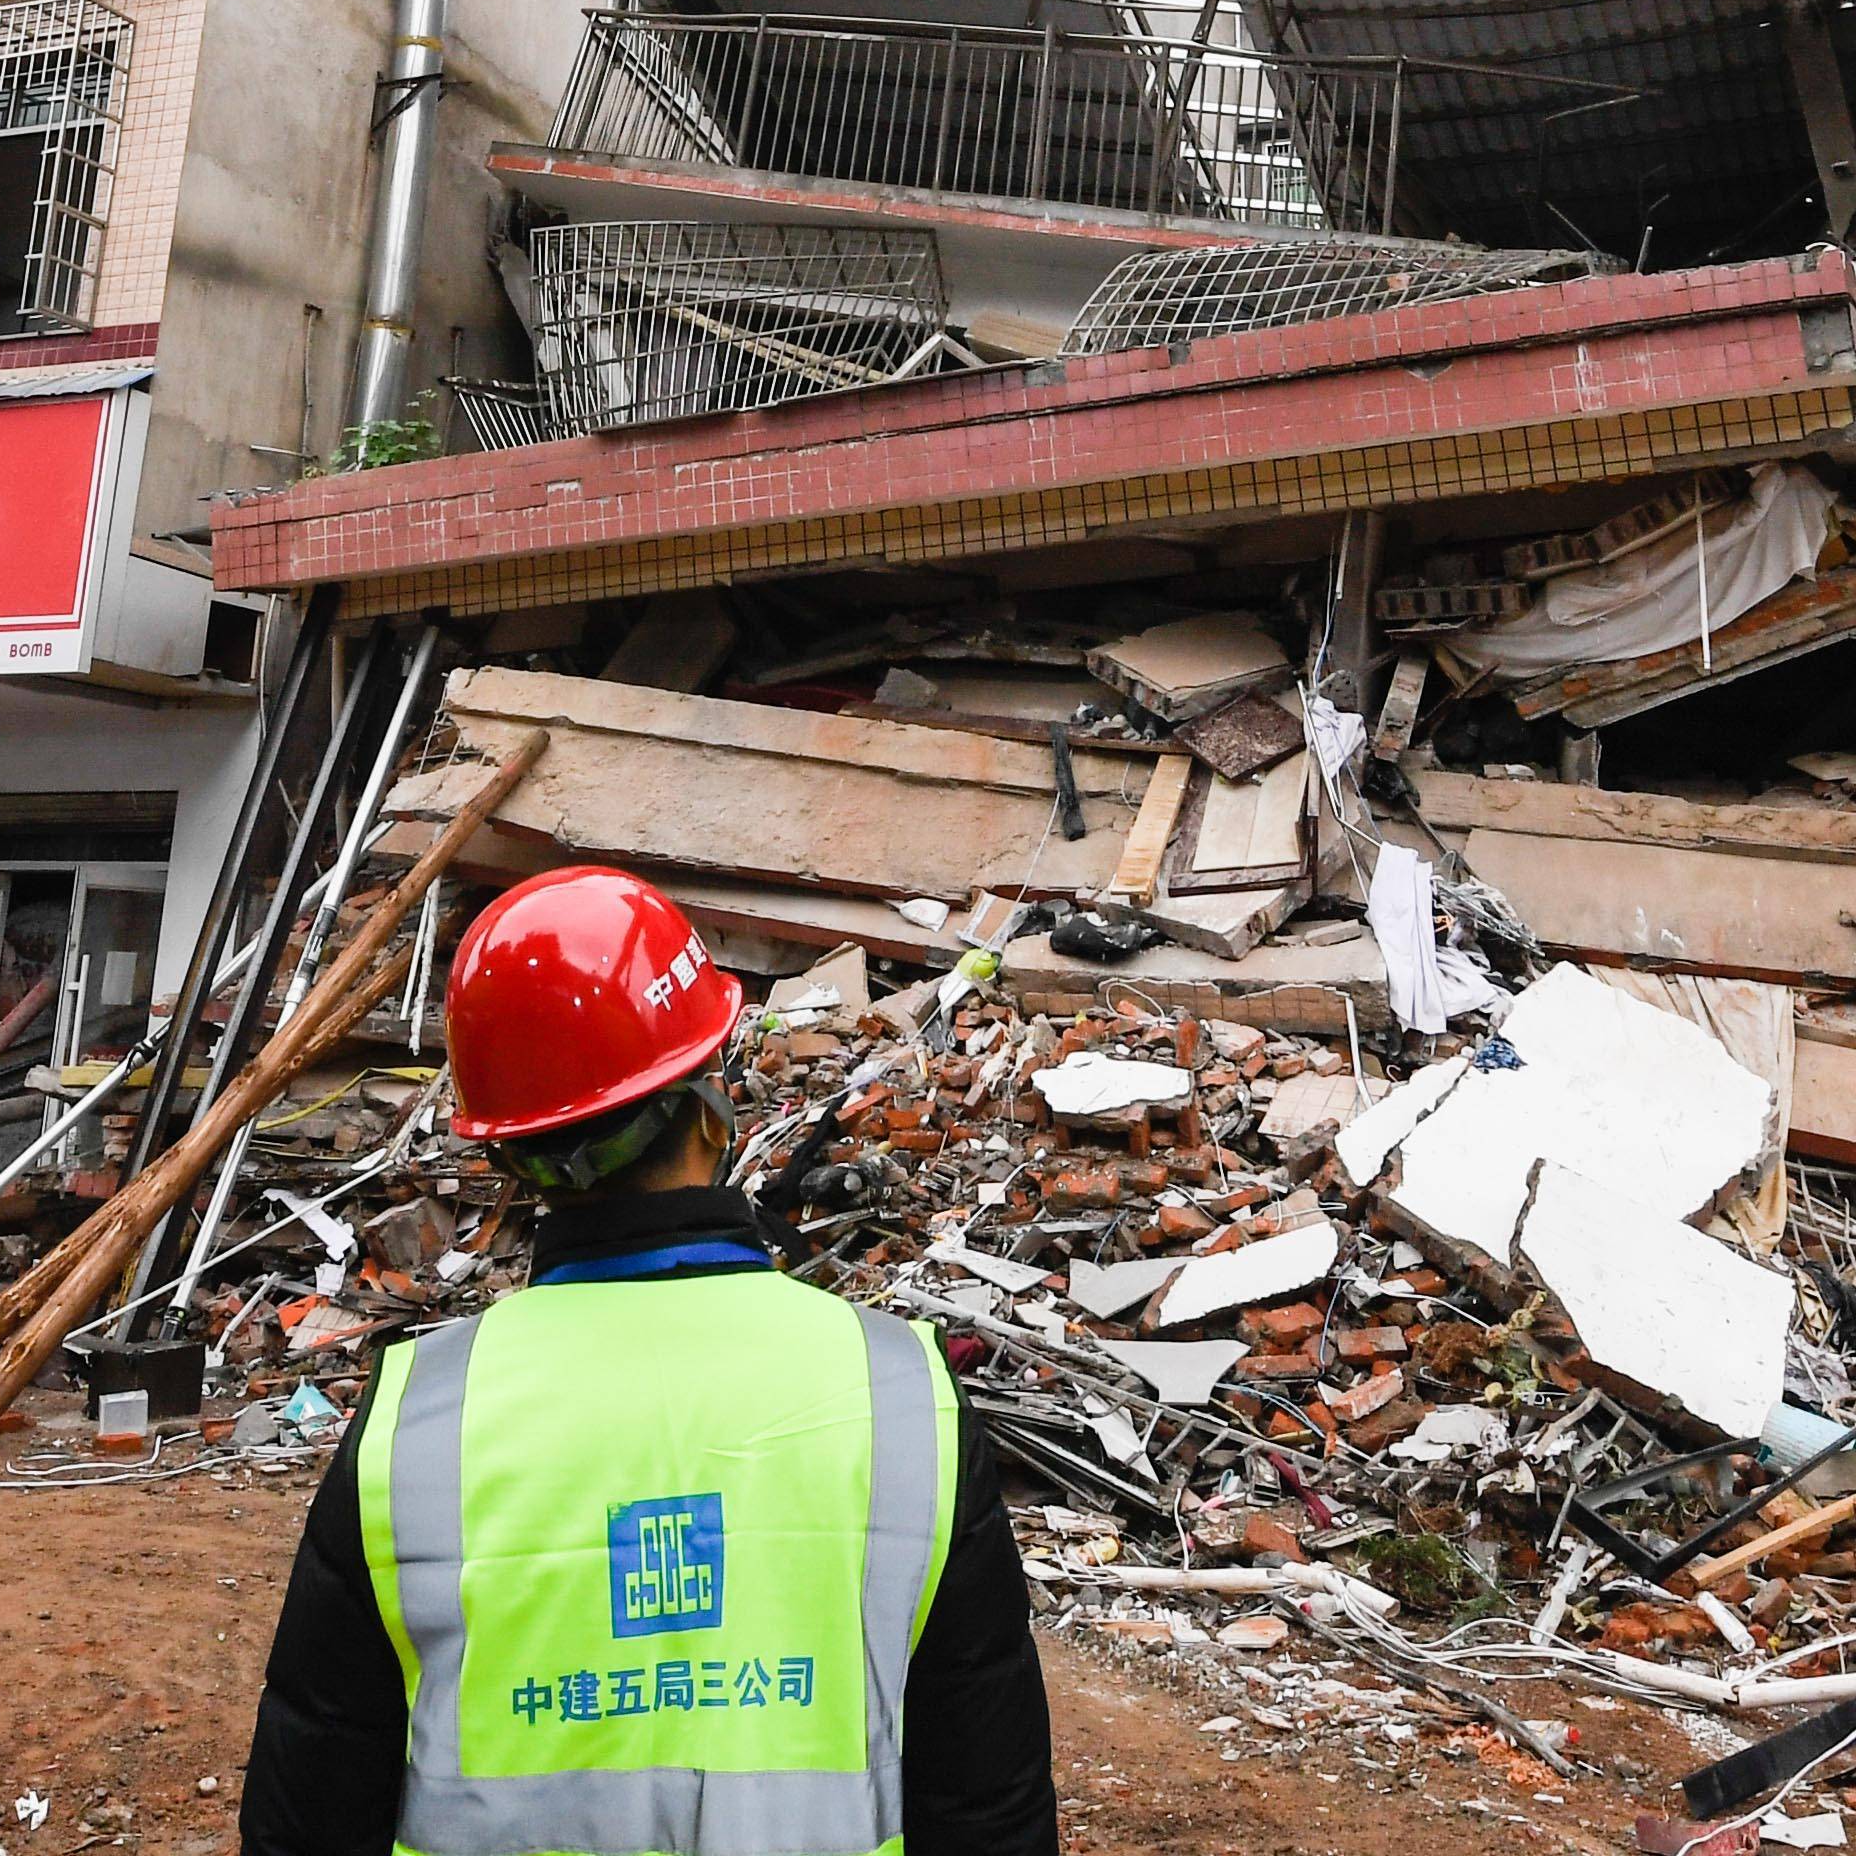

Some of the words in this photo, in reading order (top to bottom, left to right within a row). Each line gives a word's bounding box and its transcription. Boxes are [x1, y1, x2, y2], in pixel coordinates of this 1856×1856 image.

[9, 642, 53, 659] BOMB
[511, 1656, 815, 1728] 中建五局三公司
